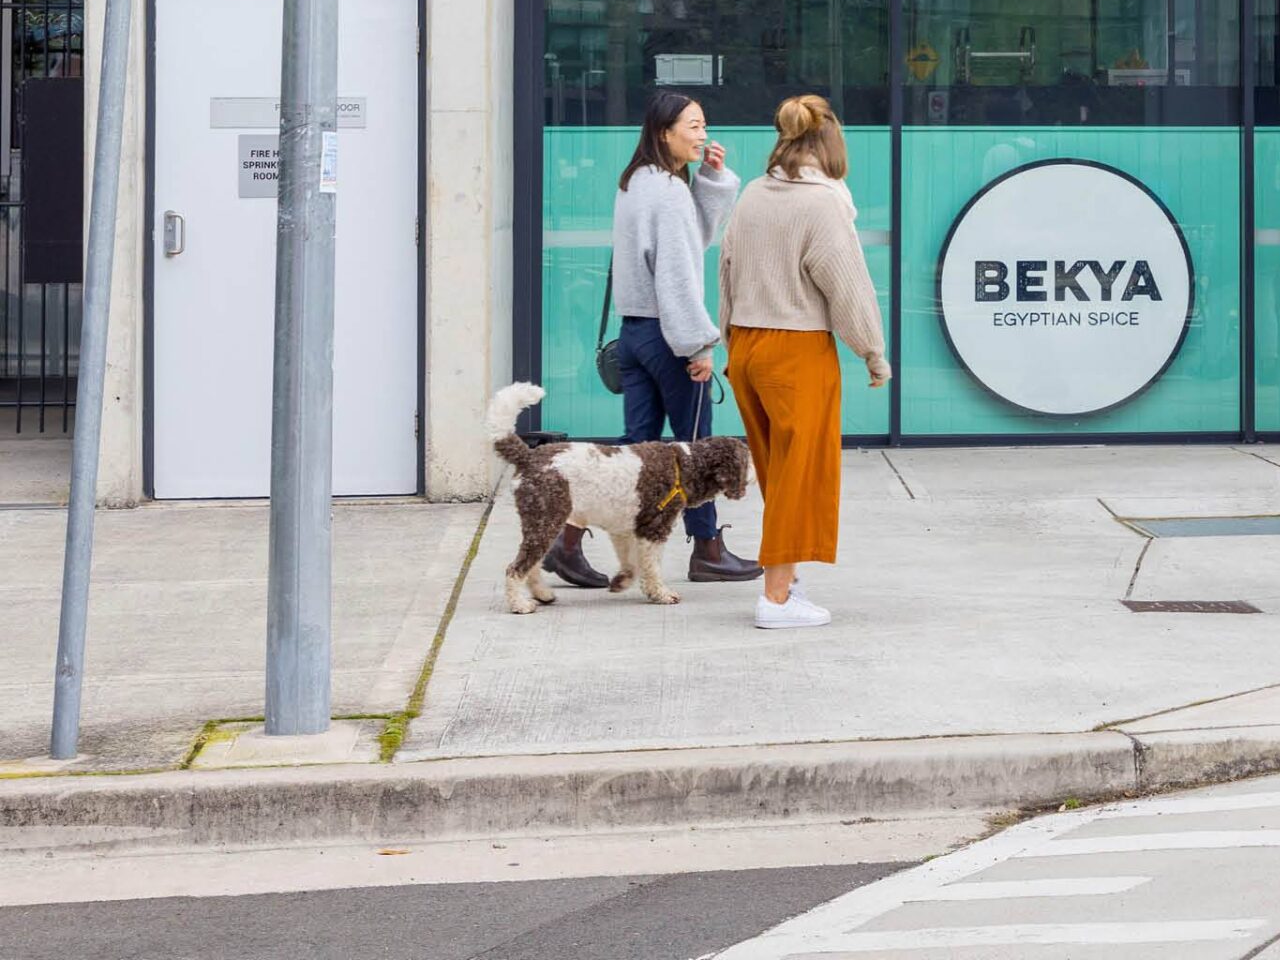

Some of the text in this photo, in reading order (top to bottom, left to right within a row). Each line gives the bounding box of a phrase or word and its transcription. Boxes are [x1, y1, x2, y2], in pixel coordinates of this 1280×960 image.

[250, 149, 271, 158] FIRE
[242, 161, 280, 169] SPRINK
[974, 260, 1163, 302] BEKYA
[993, 311, 1140, 326] EGYPTIAN SPICE
